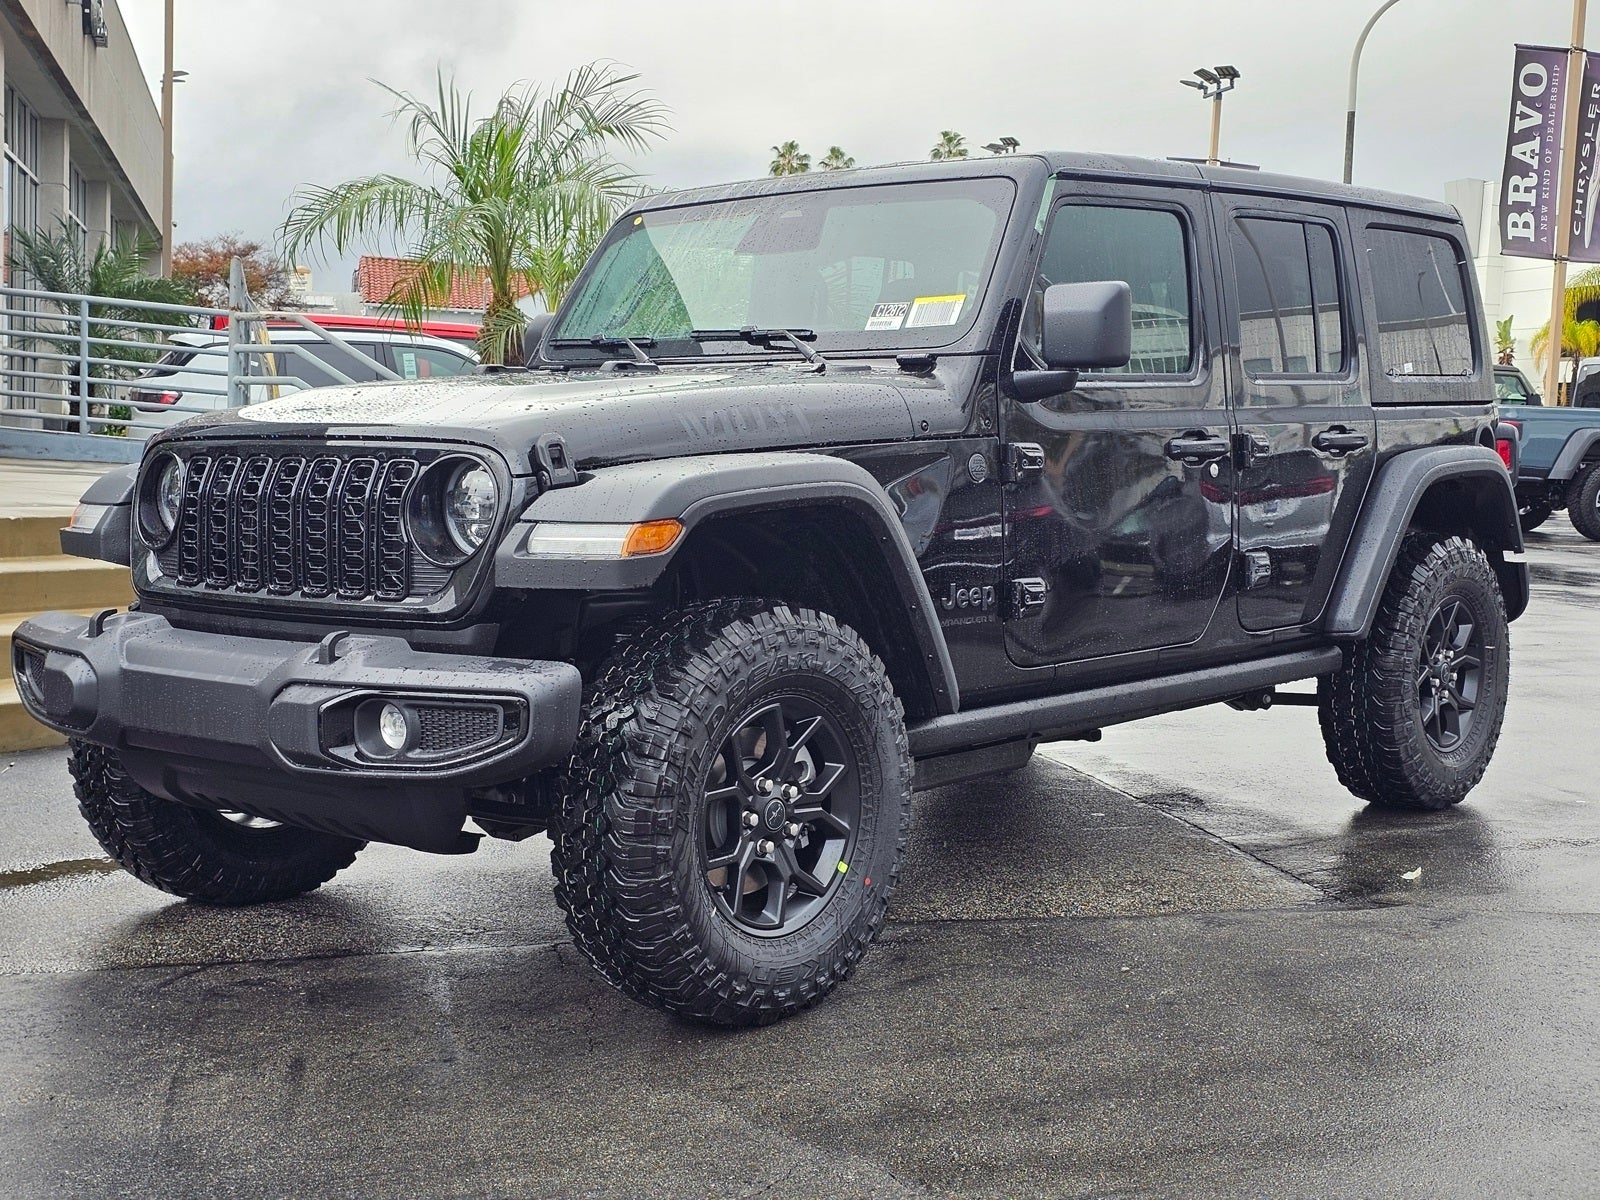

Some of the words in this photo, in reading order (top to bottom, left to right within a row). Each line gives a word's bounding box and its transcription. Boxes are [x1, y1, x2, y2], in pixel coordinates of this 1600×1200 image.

[1546, 64, 1561, 142] DEALERSHIP
[1507, 62, 1548, 242] BRAVO
[1544, 148, 1553, 163] OF
[1573, 82, 1600, 236] CHRYSLER
[1542, 169, 1551, 199] KIND
[941, 583, 996, 611] Jeep
[941, 616, 987, 627] WRANGLER
